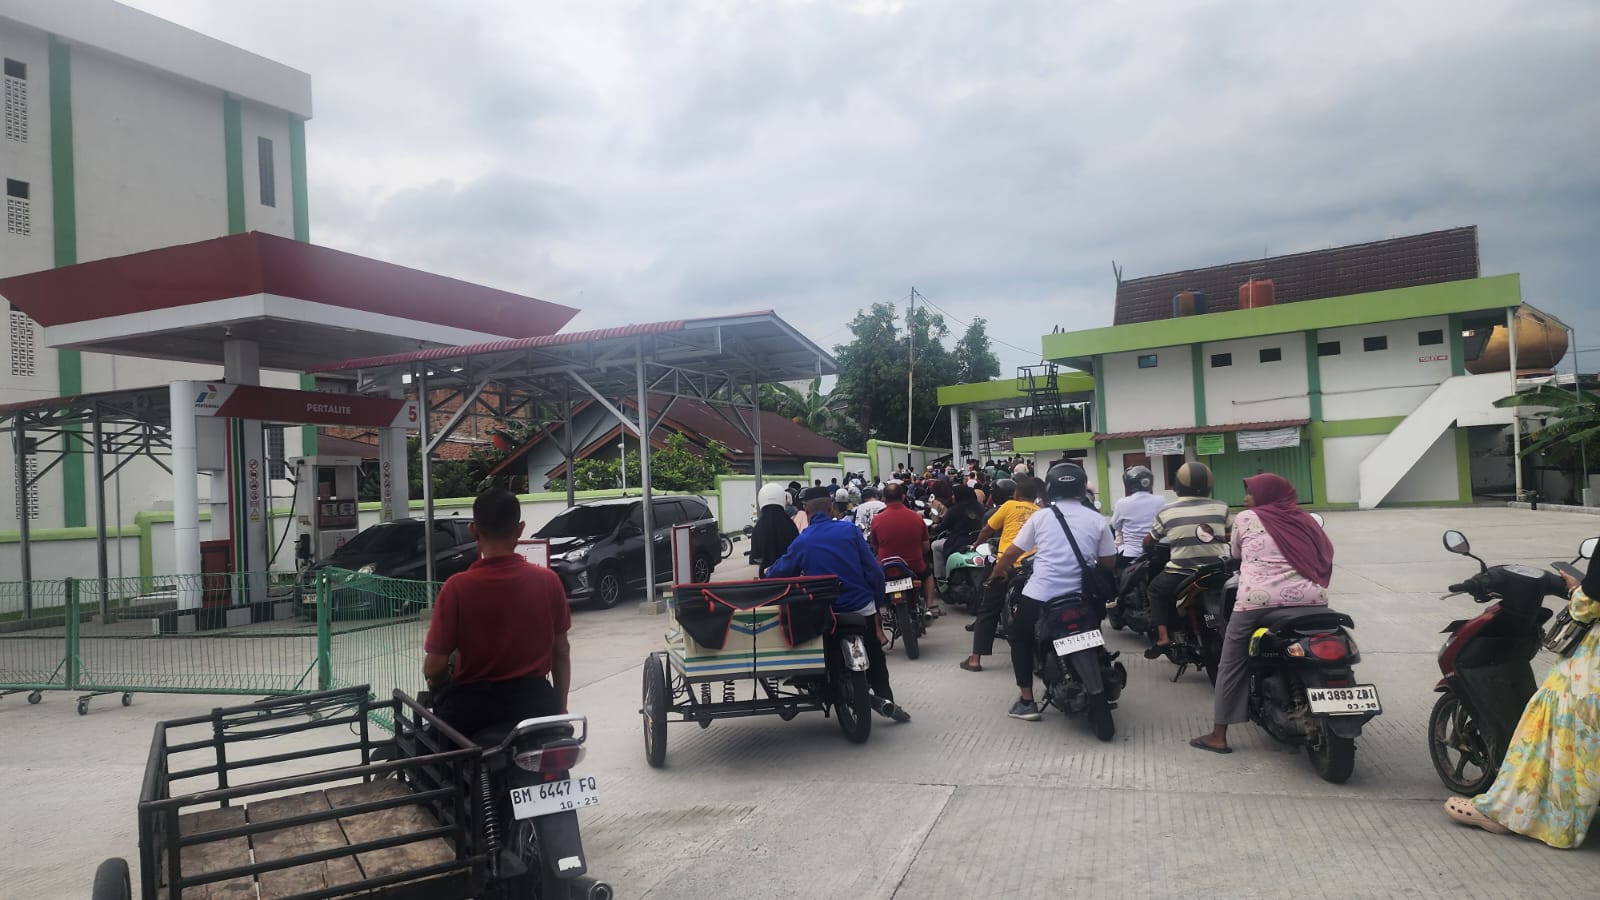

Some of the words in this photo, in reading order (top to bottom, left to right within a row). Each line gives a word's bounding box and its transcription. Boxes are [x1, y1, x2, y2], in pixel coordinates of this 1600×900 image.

[306, 403, 352, 415] PERTALITE
[408, 405, 418, 422] 5
[1054, 639, 1066, 649] BM
[1310, 690, 1326, 702] BM
[1326, 689, 1354, 701] 3893
[512, 788, 532, 805] BM
[539, 780, 571, 800] 6447
[579, 776, 597, 793] FQ
